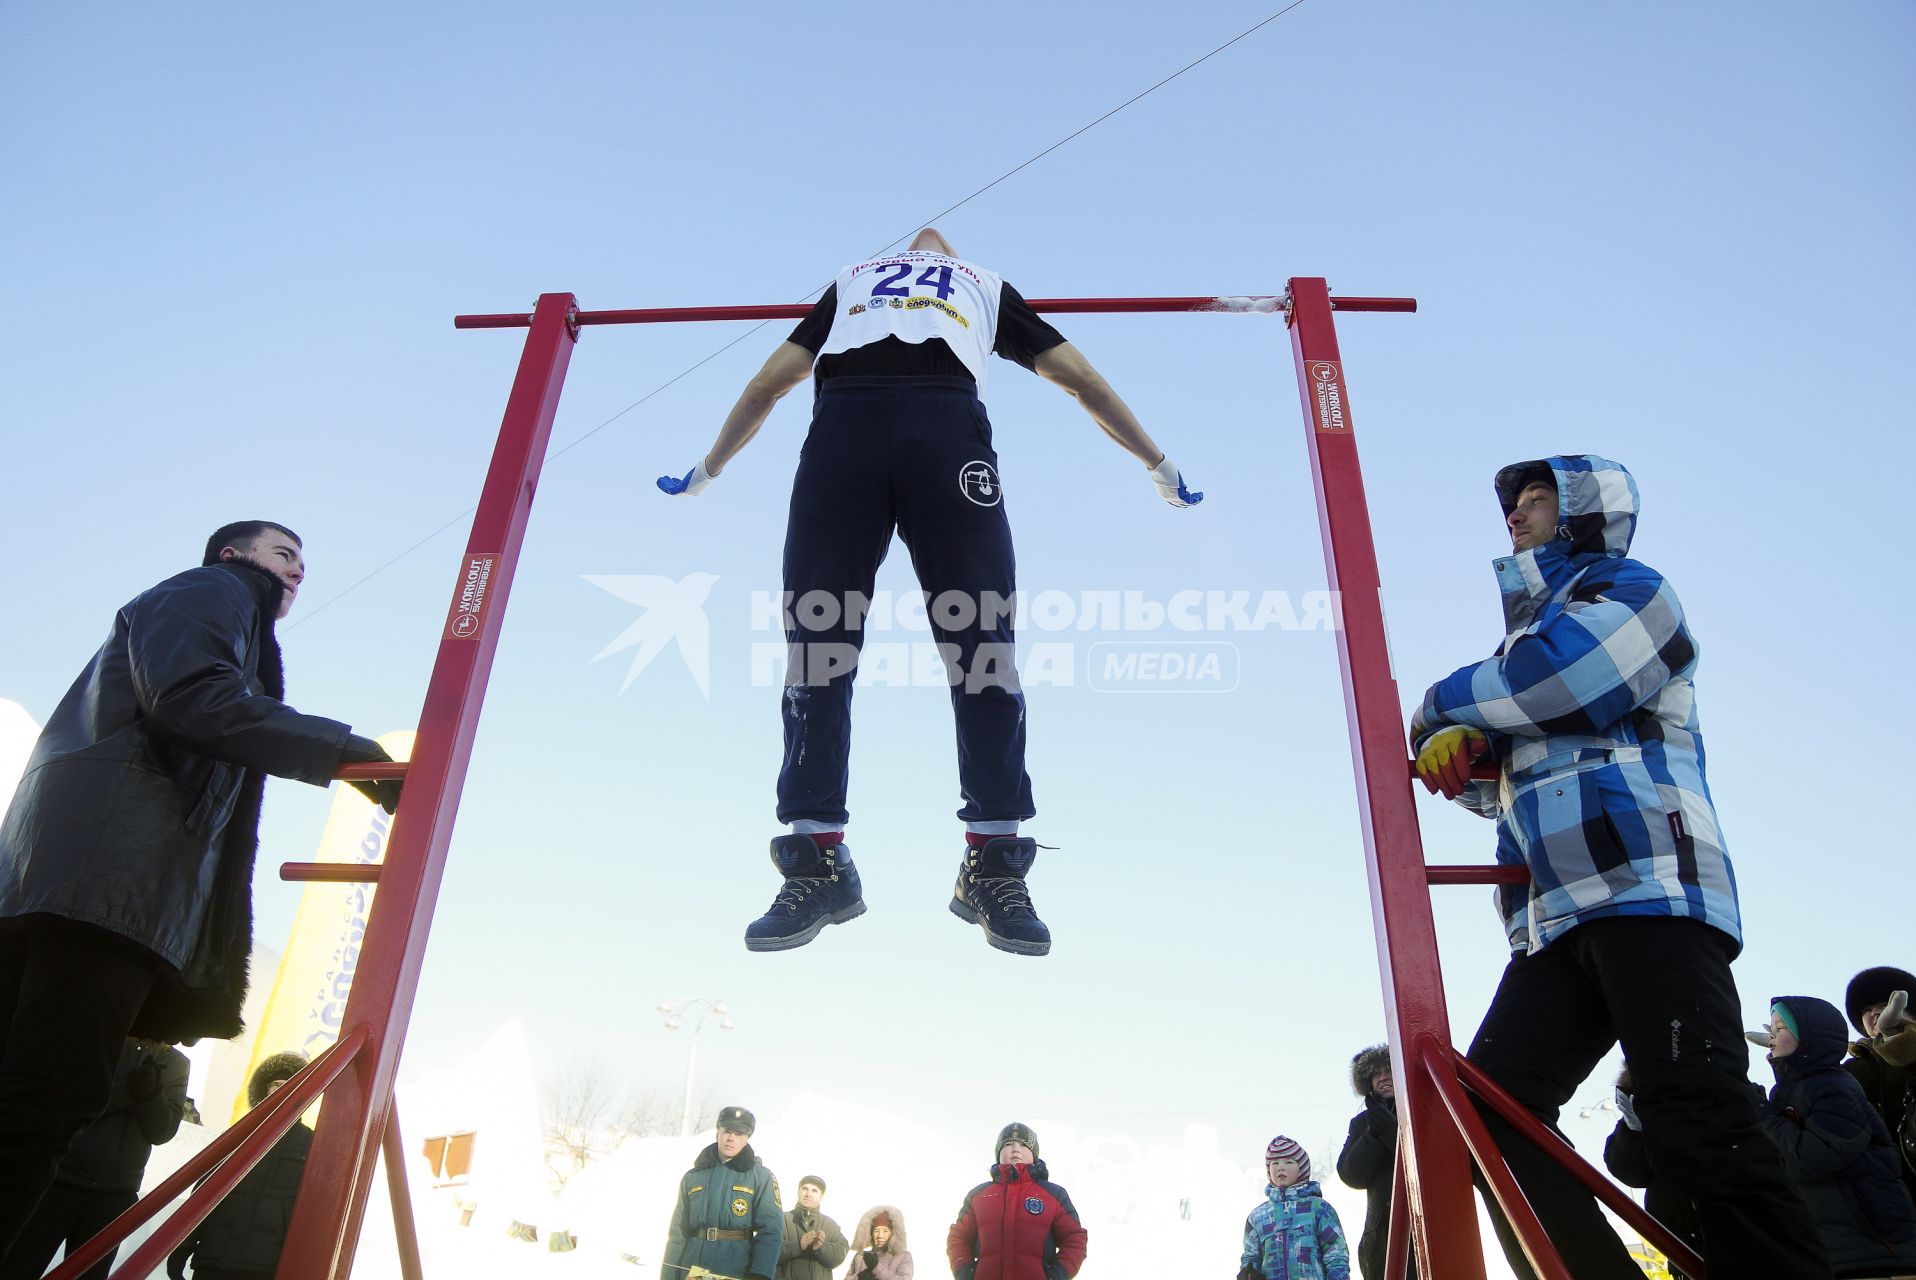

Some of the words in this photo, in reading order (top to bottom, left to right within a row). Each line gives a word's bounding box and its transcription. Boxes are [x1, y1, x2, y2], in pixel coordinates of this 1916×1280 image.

[871, 262, 955, 302] 24
[1326, 382, 1344, 429] WORKOUT
[458, 559, 482, 613] WORKOUT
[472, 559, 493, 613] EKATERINBURG
